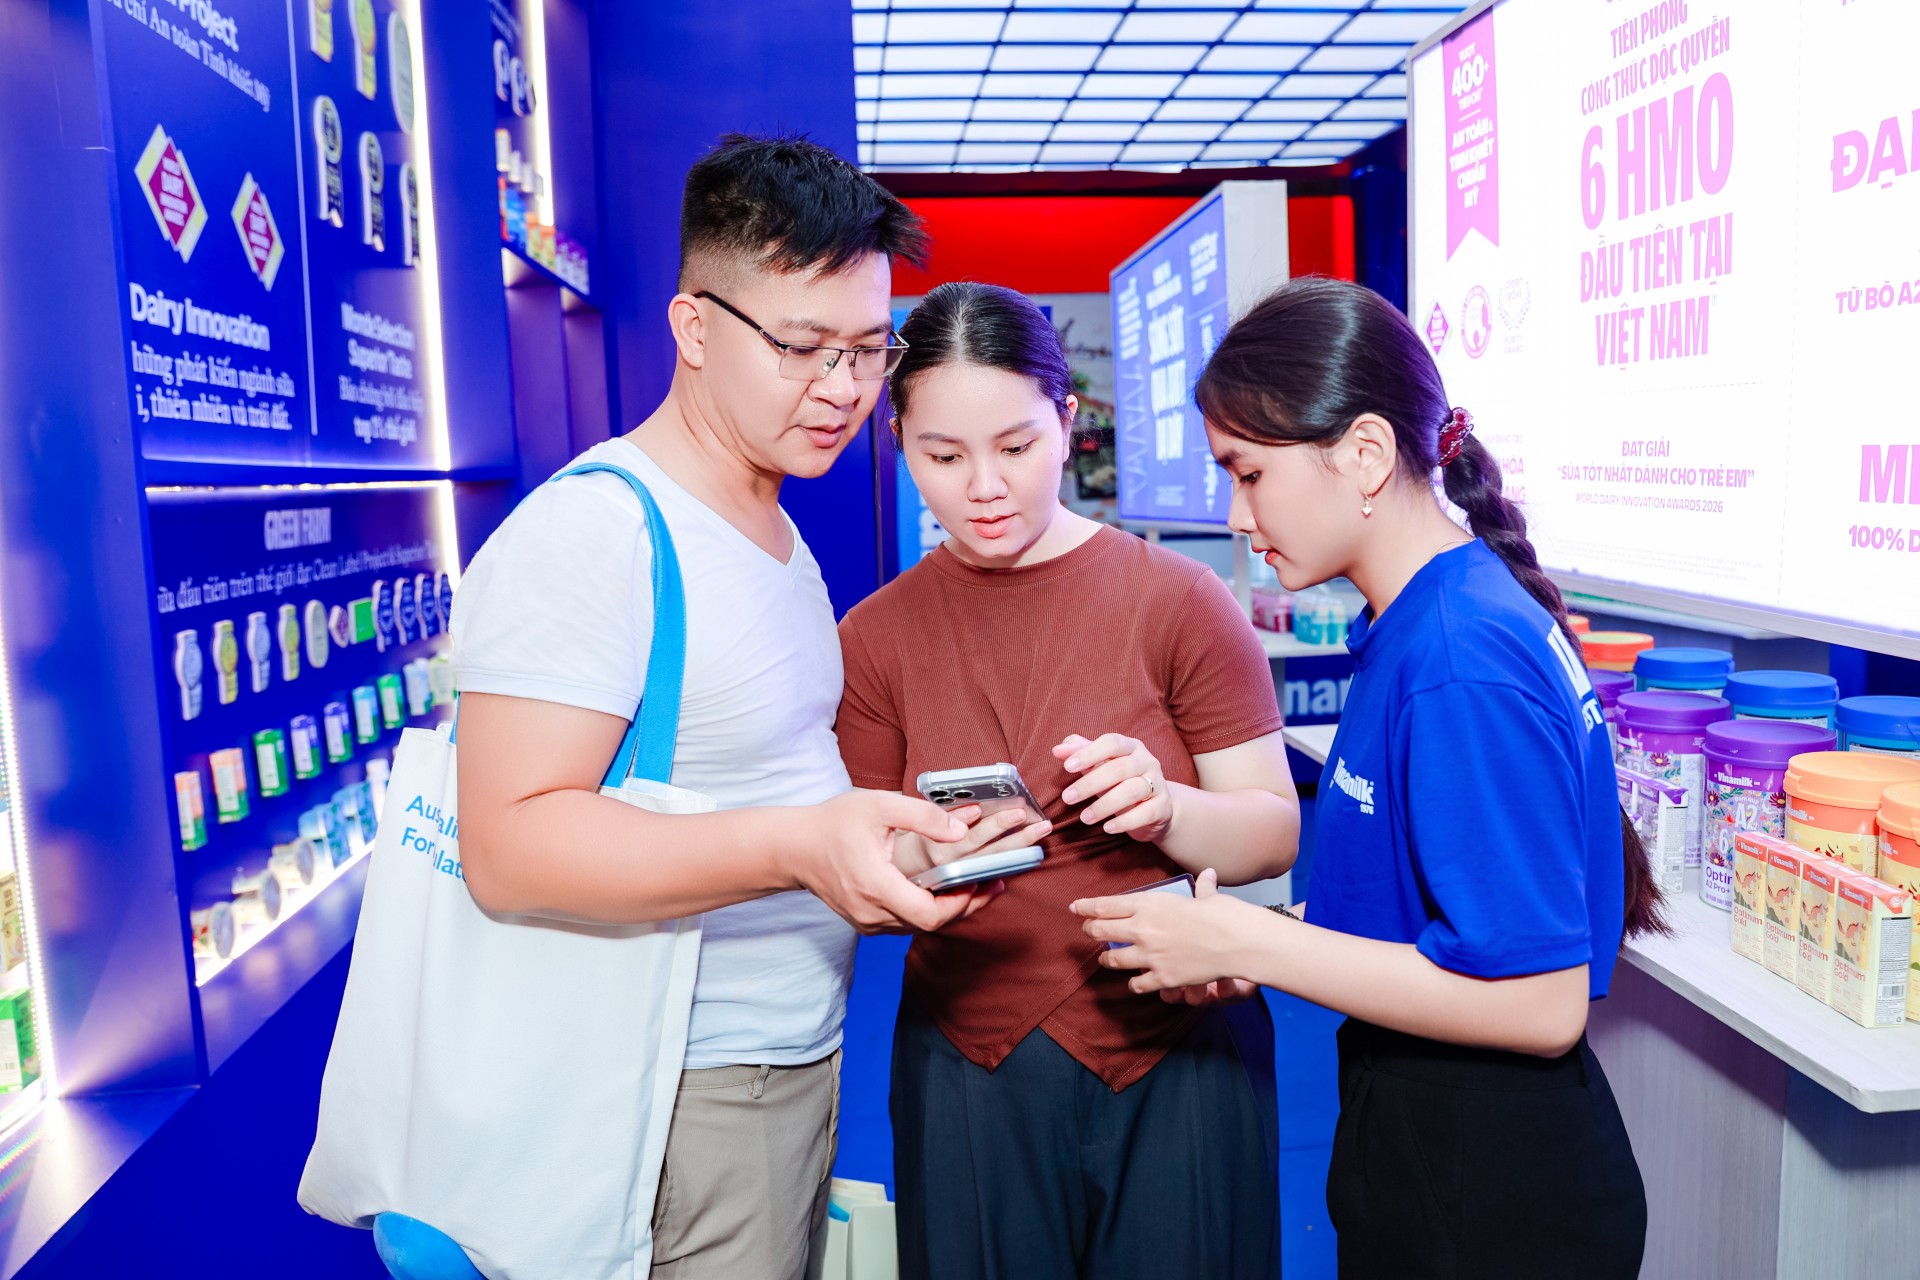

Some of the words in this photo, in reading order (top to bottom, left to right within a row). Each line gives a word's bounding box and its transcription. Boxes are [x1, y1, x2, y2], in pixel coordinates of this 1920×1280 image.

[150, 7, 171, 40] An
[1610, 18, 1638, 59] TIÊN
[1641, 0, 1688, 44] PHONG
[1581, 76, 1611, 116] CÔNG
[1650, 43, 1678, 86] ĐỘC
[1580, 125, 1606, 230] 6
[1616, 72, 1734, 221] HMO
[1580, 235, 1624, 303] ĐẦU
[1629, 223, 1683, 293] TIÊN
[1689, 212, 1733, 285] TẠI
[129, 282, 184, 336] Dairy
[185, 298, 270, 352] Innovation
[1595, 302, 1645, 370] VIỆT
[1650, 295, 1710, 361] NAM
[131, 340, 174, 386] hững
[1670, 467, 1697, 486] CHO
[1576, 493, 1600, 504] WORLD
[1600, 494, 1619, 505] DAIRY
[1621, 495, 1666, 509] INNOVATION
[1666, 498, 1701, 511] AWARDS
[1702, 500, 1723, 513] 2026
[1849, 525, 1904, 552] 100%
[1718, 771, 1753, 787] Vinamilk
[1360, 804, 1374, 815] 1976
[1734, 802, 1758, 830] A2
[1719, 828, 1729, 854] 6
[1734, 906, 1763, 925] Optimum
[1734, 915, 1747, 927] Gold
[1766, 922, 1796, 942] Optimum
[1766, 931, 1779, 943] Gold
[1834, 959, 1866, 982] Optimum
[1834, 967, 1849, 982] Gold
